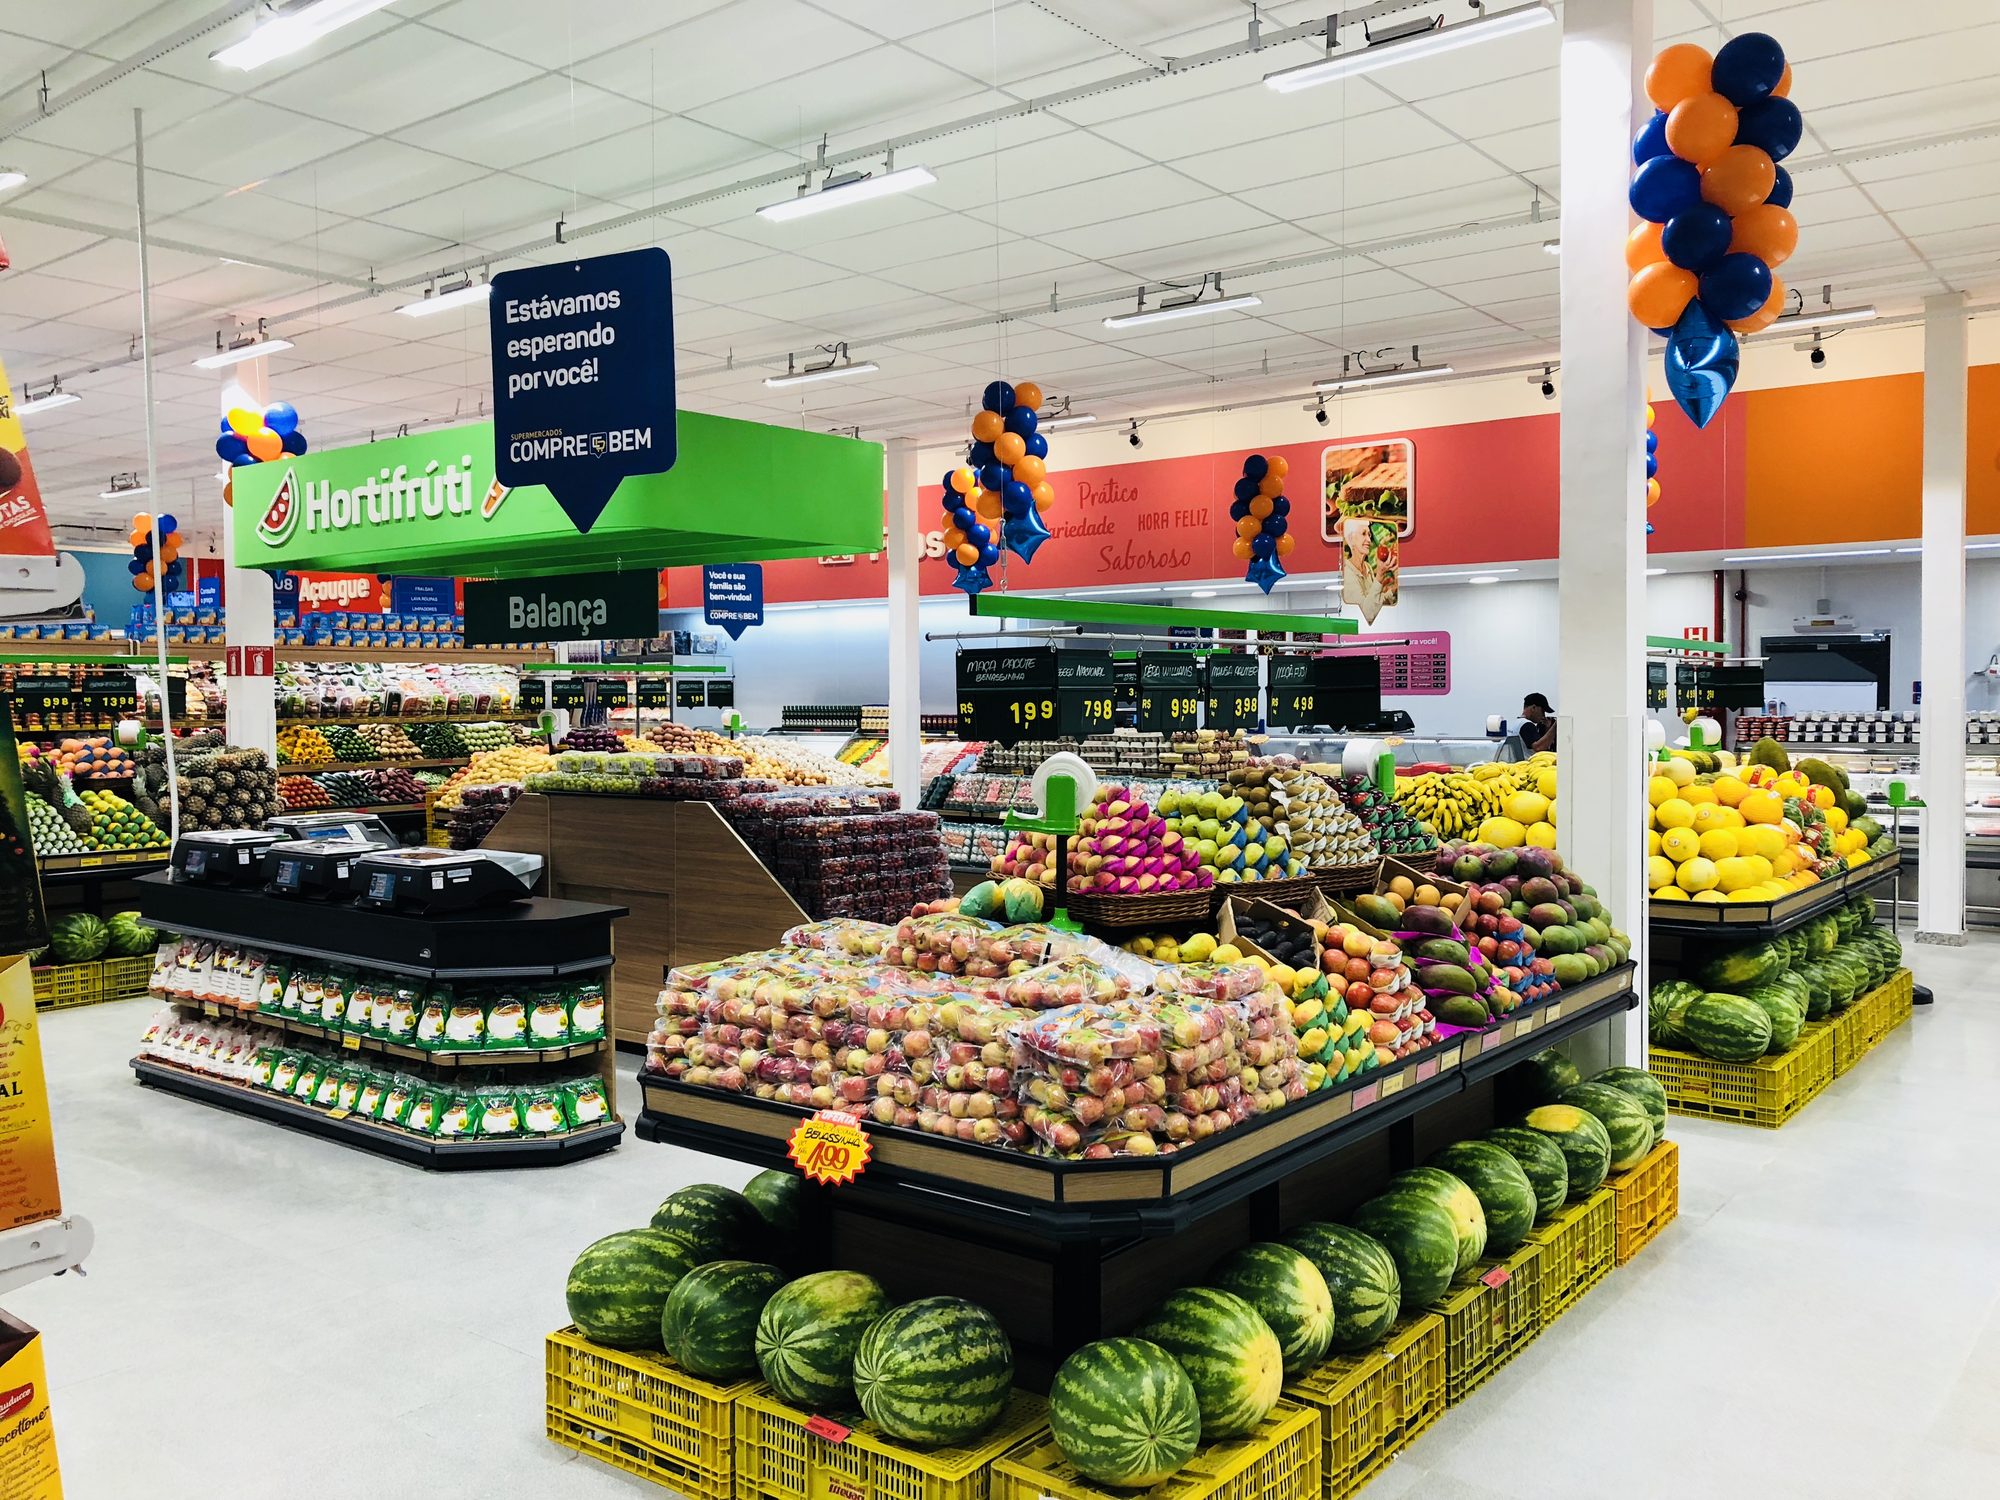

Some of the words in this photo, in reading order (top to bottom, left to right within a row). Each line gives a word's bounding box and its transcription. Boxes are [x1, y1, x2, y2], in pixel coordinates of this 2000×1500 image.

[505, 290, 621, 324] Estávamos
[507, 322, 616, 361] esperando
[509, 370, 543, 399] por
[543, 357, 599, 387] você!
[510, 428, 563, 440] SUPERMERCADOS
[510, 434, 588, 463] COMPRE
[609, 427, 652, 452] BEM
[306, 455, 472, 531] Hortifrúti
[1077, 477, 1139, 509] Prático
[1046, 515, 1116, 540] ariedade
[1138, 511, 1169, 532] HORA
[1175, 507, 1208, 528] FELIZ
[1097, 539, 1191, 573] Saboroso
[709, 570, 726, 580] Você
[298, 576, 370, 609] Açougue
[509, 592, 607, 636] Balança
[710, 612, 738, 620] COMPRE
[743, 612, 758, 620] BEM
[959, 701, 974, 715] R$
[1010, 700, 1053, 730] 1,99
[1084, 699, 1112, 726] 7,98
[1142, 698, 1152, 709] R$
[1171, 698, 1197, 722] 9,98
[1235, 697, 1257, 720] 3,98
[1293, 696, 1314, 718] 4,98
